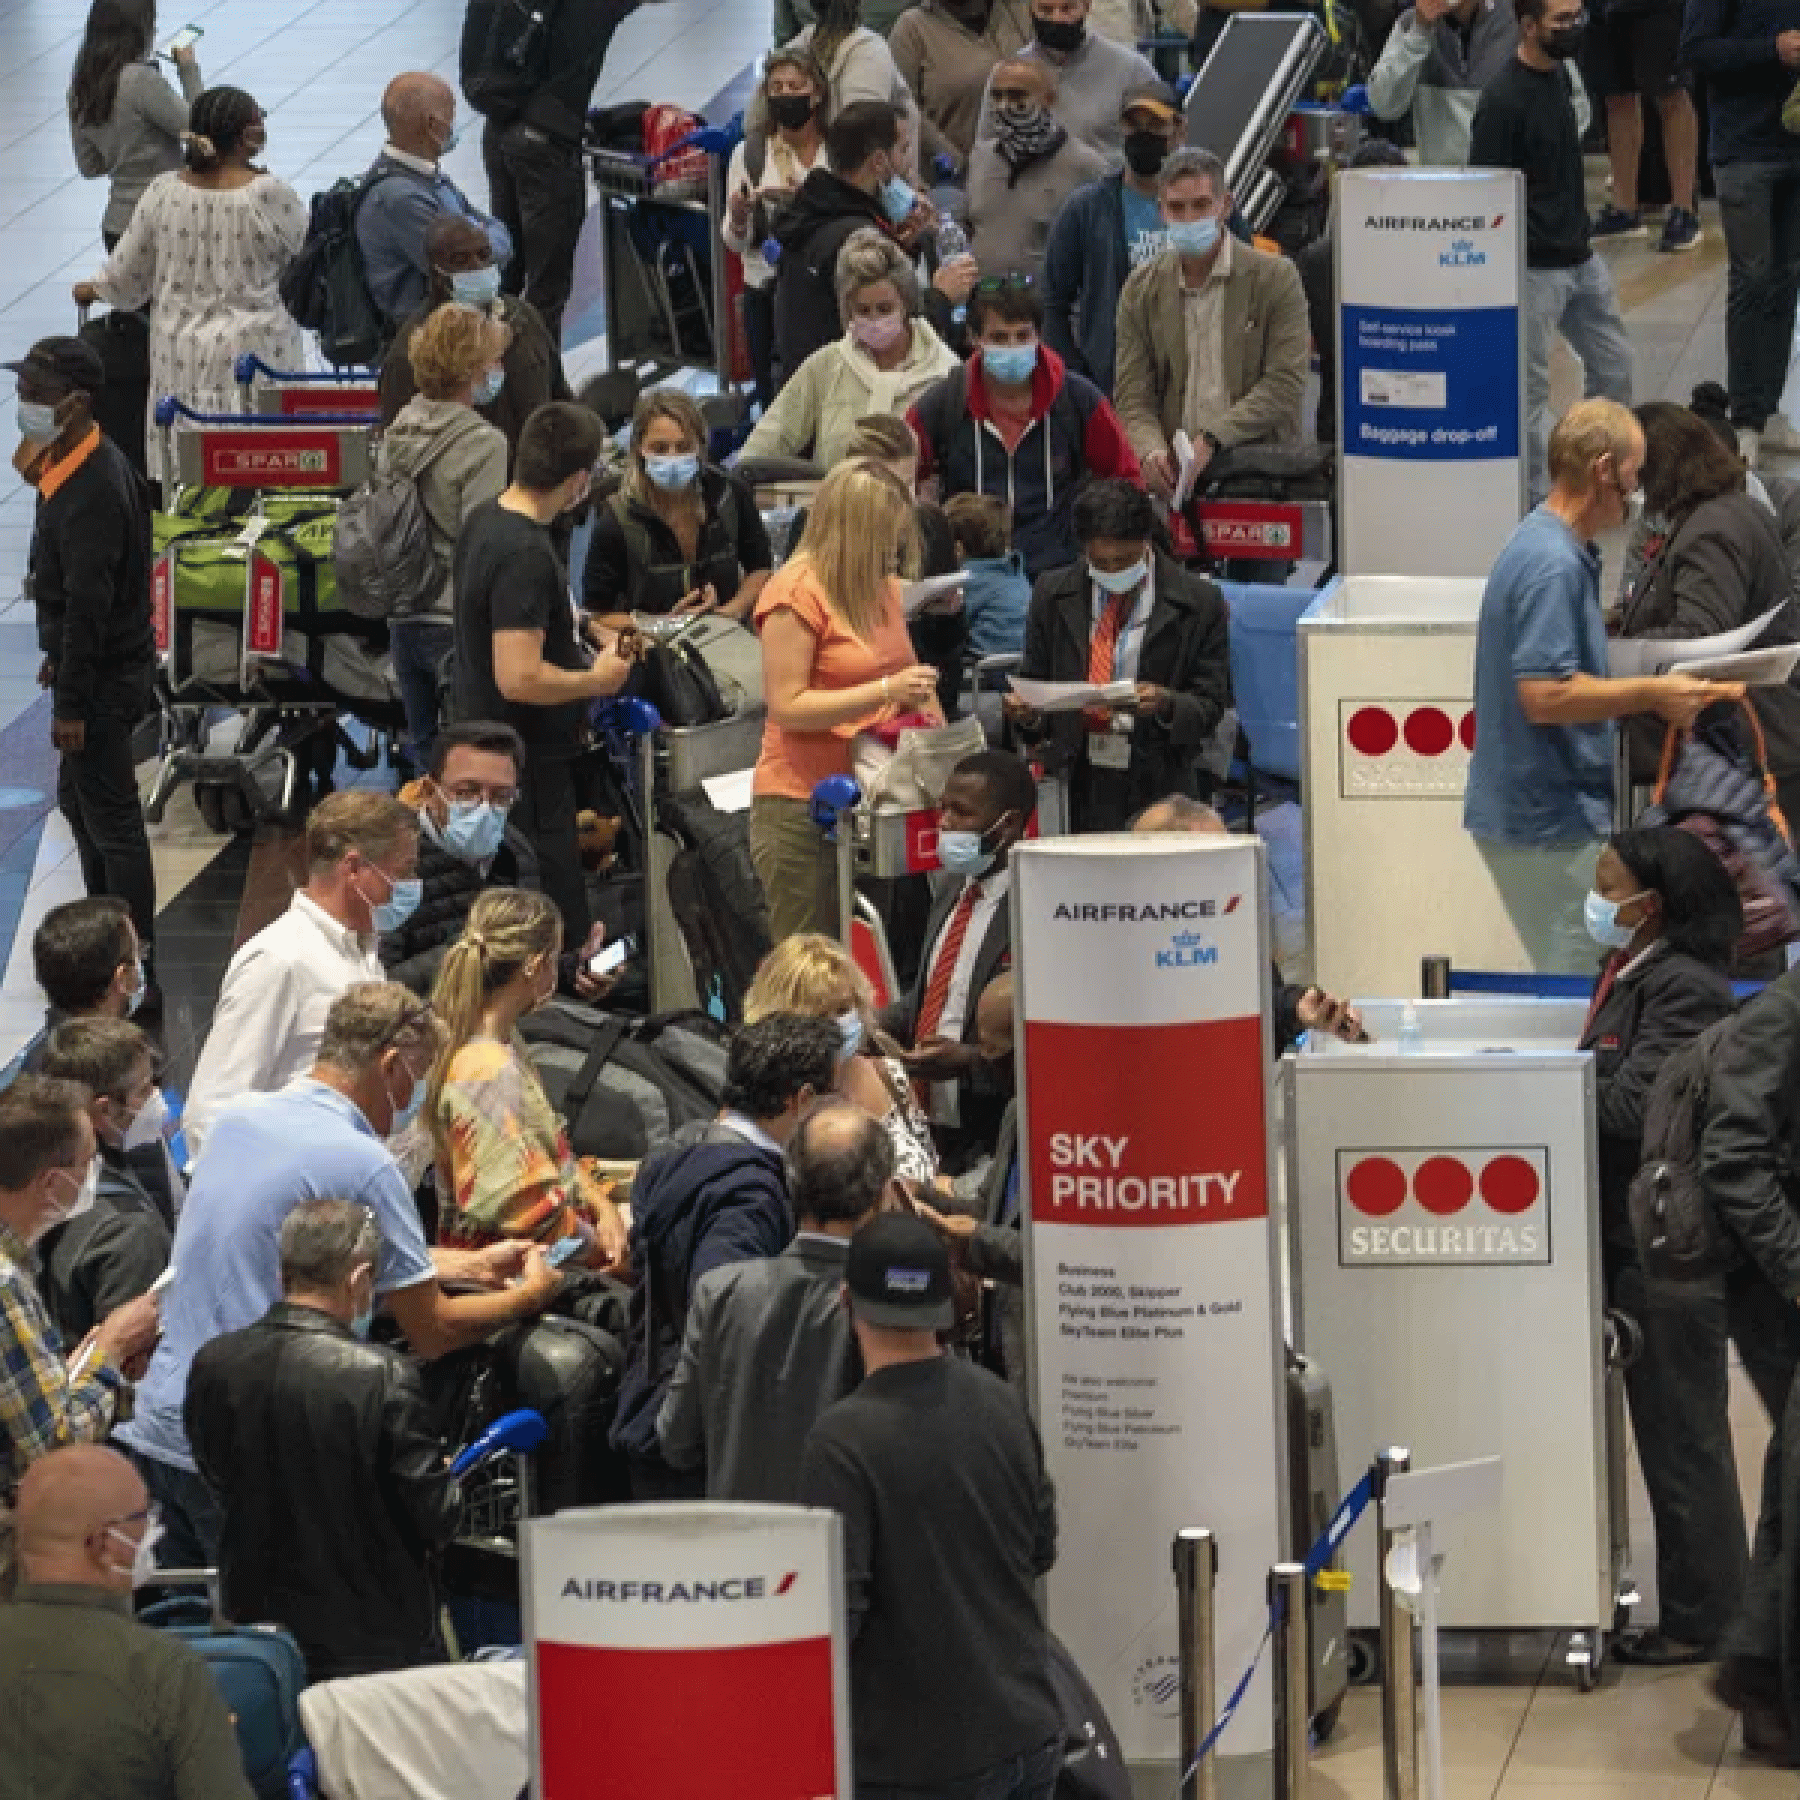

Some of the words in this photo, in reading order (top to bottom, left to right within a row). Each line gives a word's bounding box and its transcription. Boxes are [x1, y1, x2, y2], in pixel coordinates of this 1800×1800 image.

[1364, 215, 1486, 231] AIRFRANCE
[1438, 251, 1486, 266] KLM
[1360, 423, 1428, 446] Baggage
[1431, 425, 1498, 445] drop-off
[1053, 899, 1216, 922] AIRFRANCE
[1155, 948, 1218, 967] KLM
[1050, 1132, 1129, 1168] SKY
[1052, 1169, 1242, 1210] PRIORITY
[1351, 1225, 1537, 1255] SECURITAS
[1058, 1302, 1097, 1321] Flying
[1100, 1303, 1129, 1319] Blue
[1132, 1303, 1195, 1319] Platinum
[561, 1577, 765, 1603] AIRFRANCE
